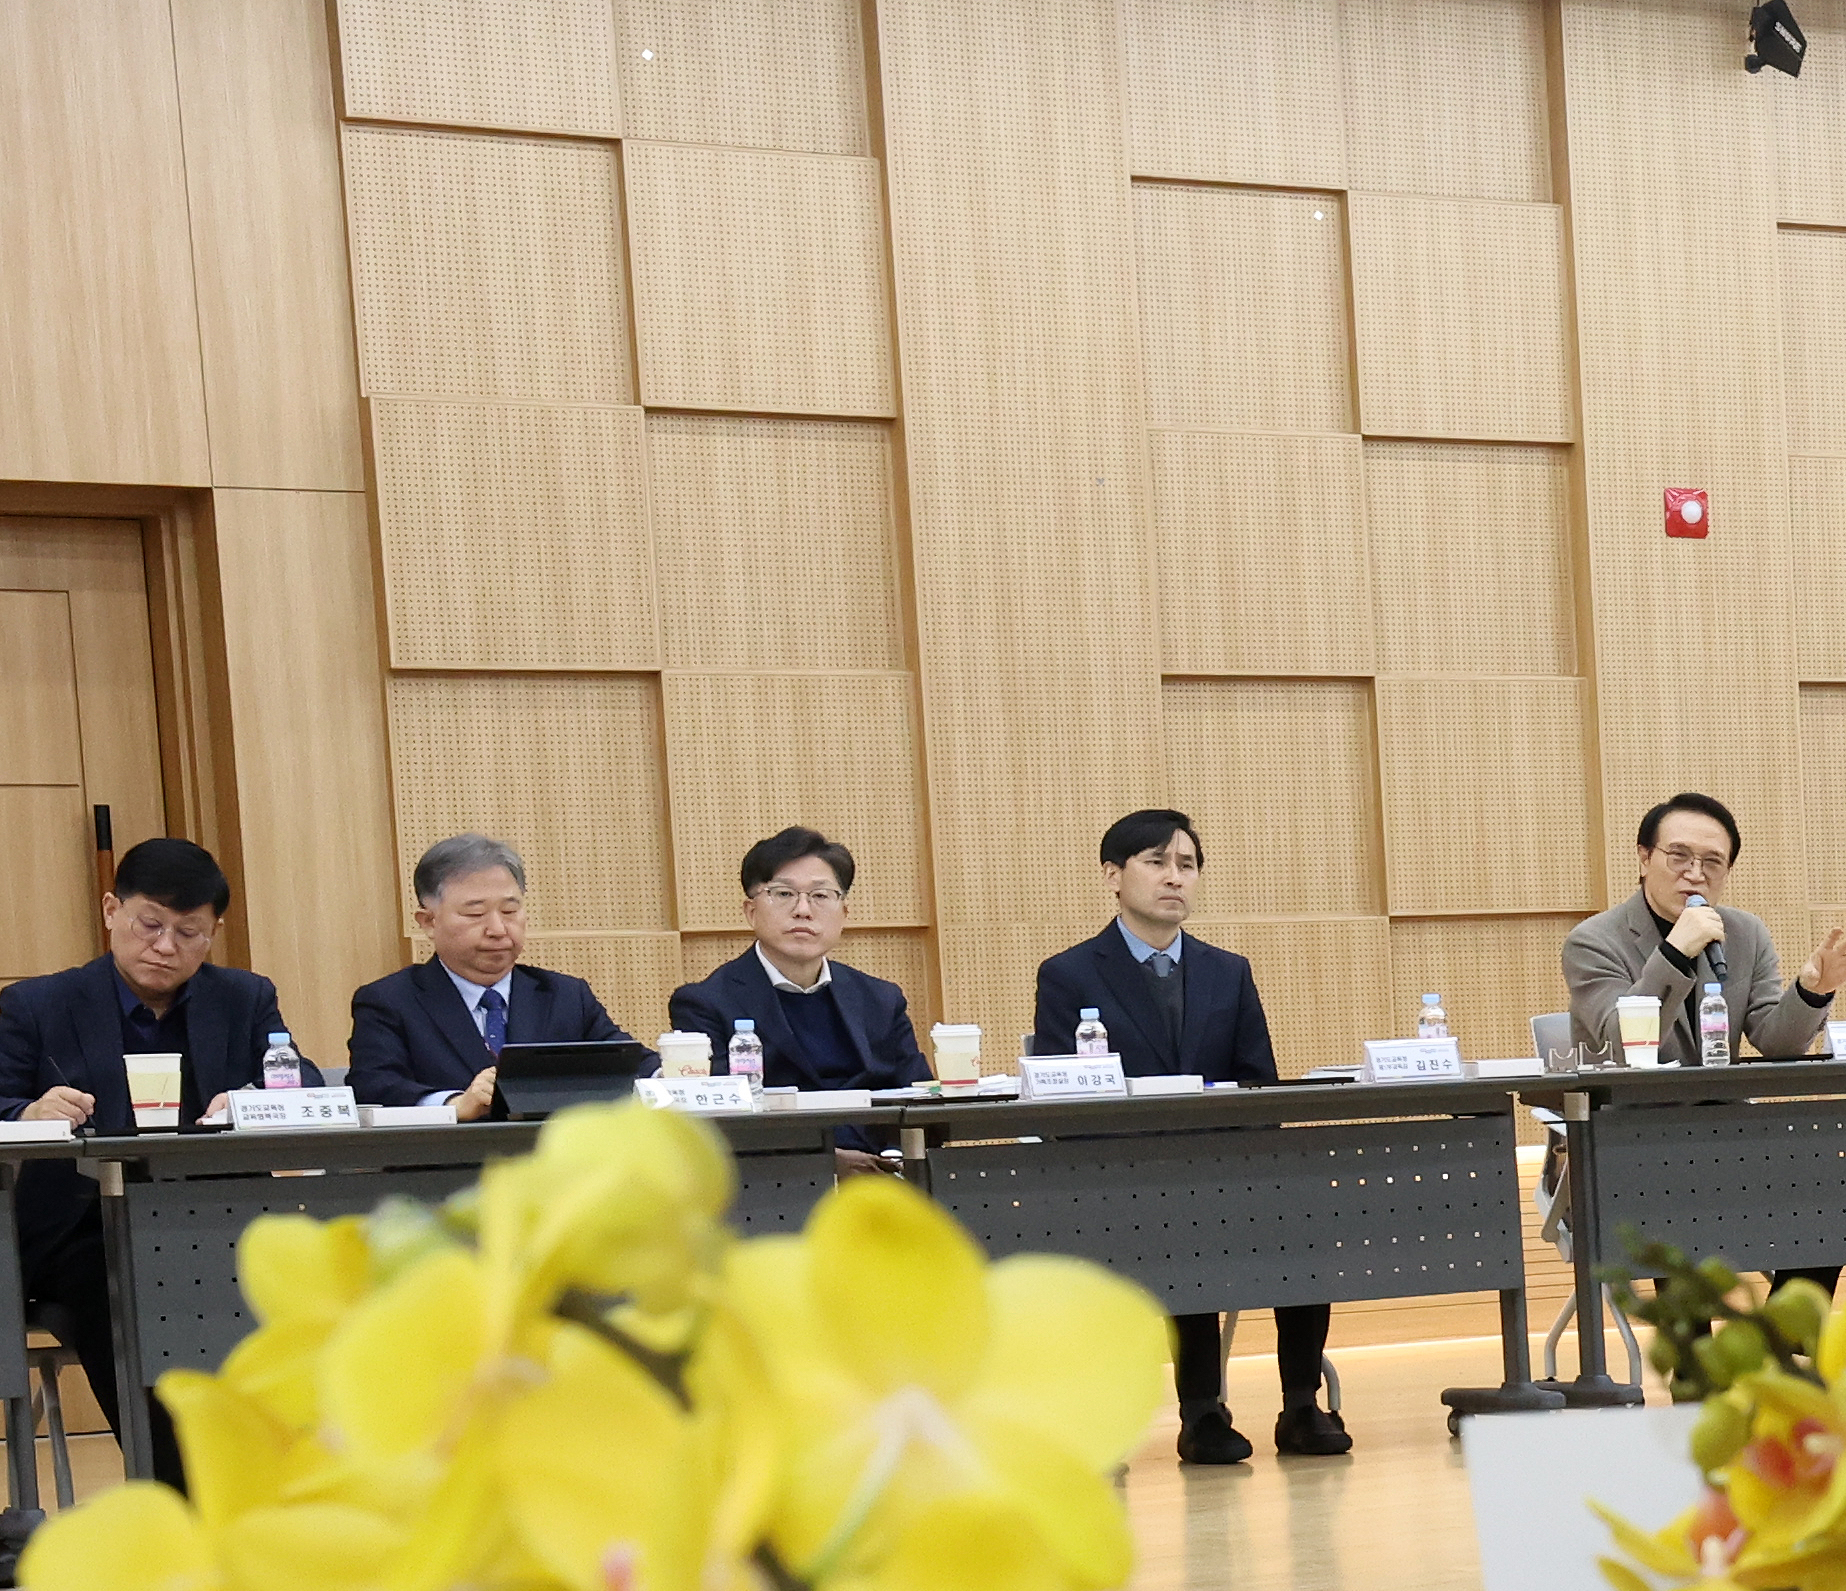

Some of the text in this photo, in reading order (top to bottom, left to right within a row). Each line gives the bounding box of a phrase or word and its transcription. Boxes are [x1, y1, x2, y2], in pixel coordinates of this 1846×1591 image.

[1416, 1059, 1452, 1071] 김진수
[1077, 1074, 1116, 1086] 이강국
[695, 1093, 741, 1105] 한근수
[241, 1104, 285, 1112] 경기도교육청
[301, 1105, 351, 1118] 조중복
